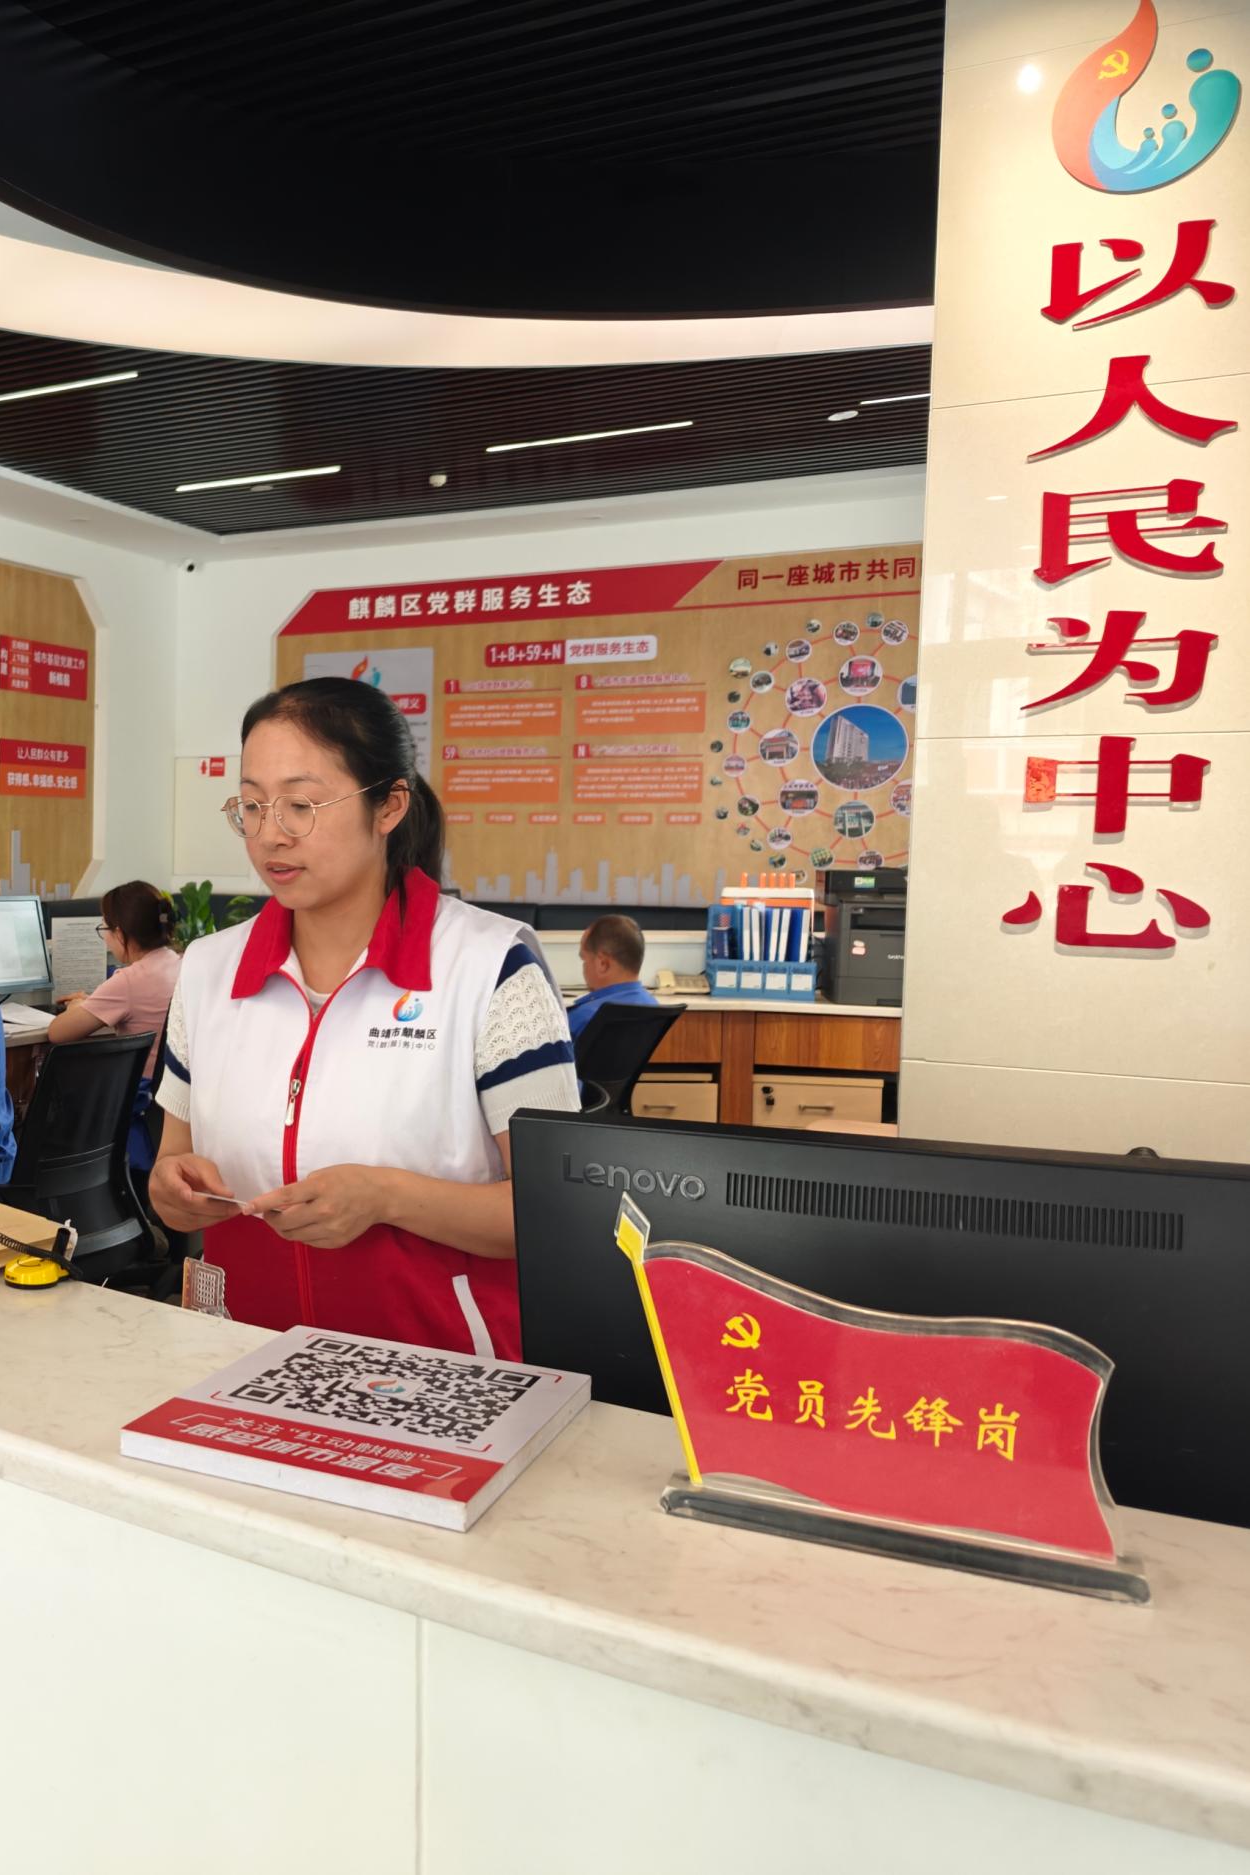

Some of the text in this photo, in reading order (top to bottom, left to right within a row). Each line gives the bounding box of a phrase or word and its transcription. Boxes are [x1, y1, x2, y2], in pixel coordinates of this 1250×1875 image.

[737, 557, 916, 590] 同一座城市共同
[1000, 218, 1241, 955] 以人民为中心
[348, 581, 592, 620] 麒麟区党群服务生态
[569, 641, 651, 658] 党群服务生态
[369, 1027, 437, 1040] 曲靖市麒麟区
[562, 1152, 706, 1200] Lenovo
[725, 1368, 1020, 1462] 党员先锋岗
[181, 1423, 425, 1479] 感受城市温度
